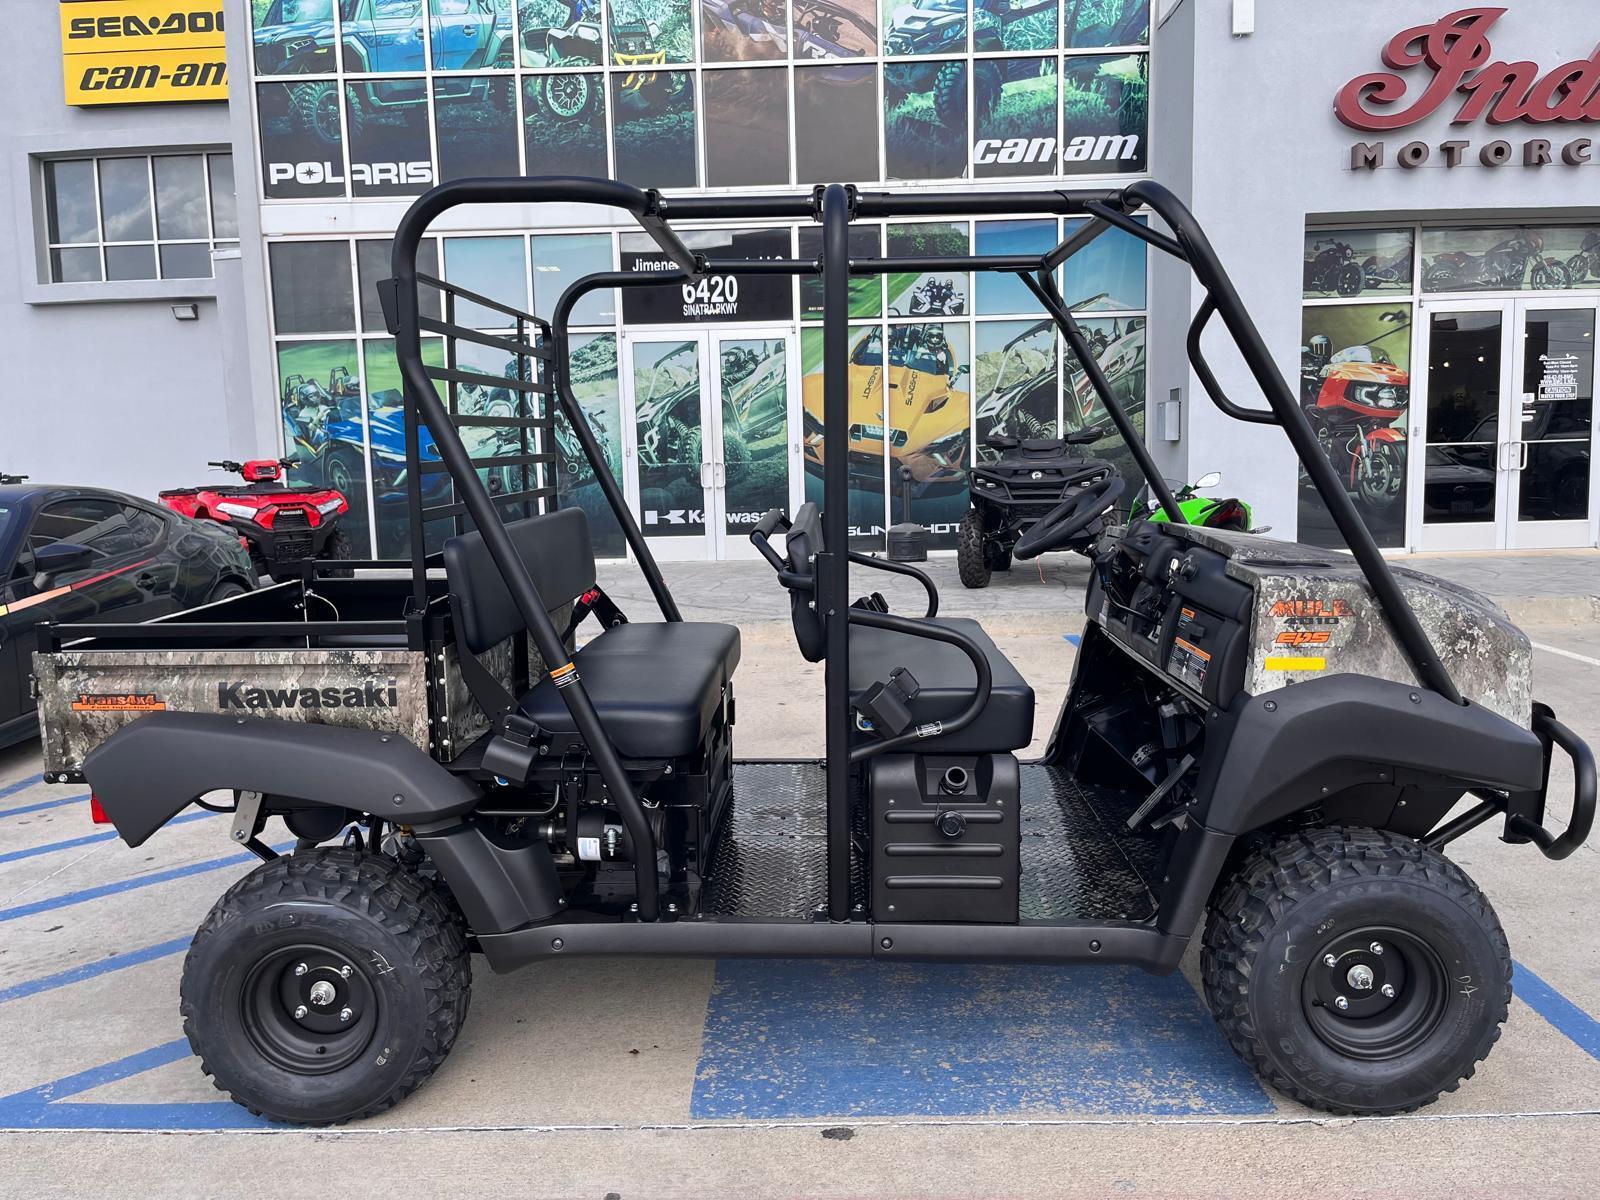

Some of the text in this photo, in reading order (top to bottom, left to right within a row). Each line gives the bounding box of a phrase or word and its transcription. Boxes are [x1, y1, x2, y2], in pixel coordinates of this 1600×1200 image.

[269, 161, 433, 185] POLARIS
[632, 259, 680, 272] Jimene
[682, 276, 738, 304] 6420
[683, 302, 738, 316] SINATRA PKWY
[1265, 599, 1356, 617] MULE
[218, 680, 397, 709] Kawasaki
